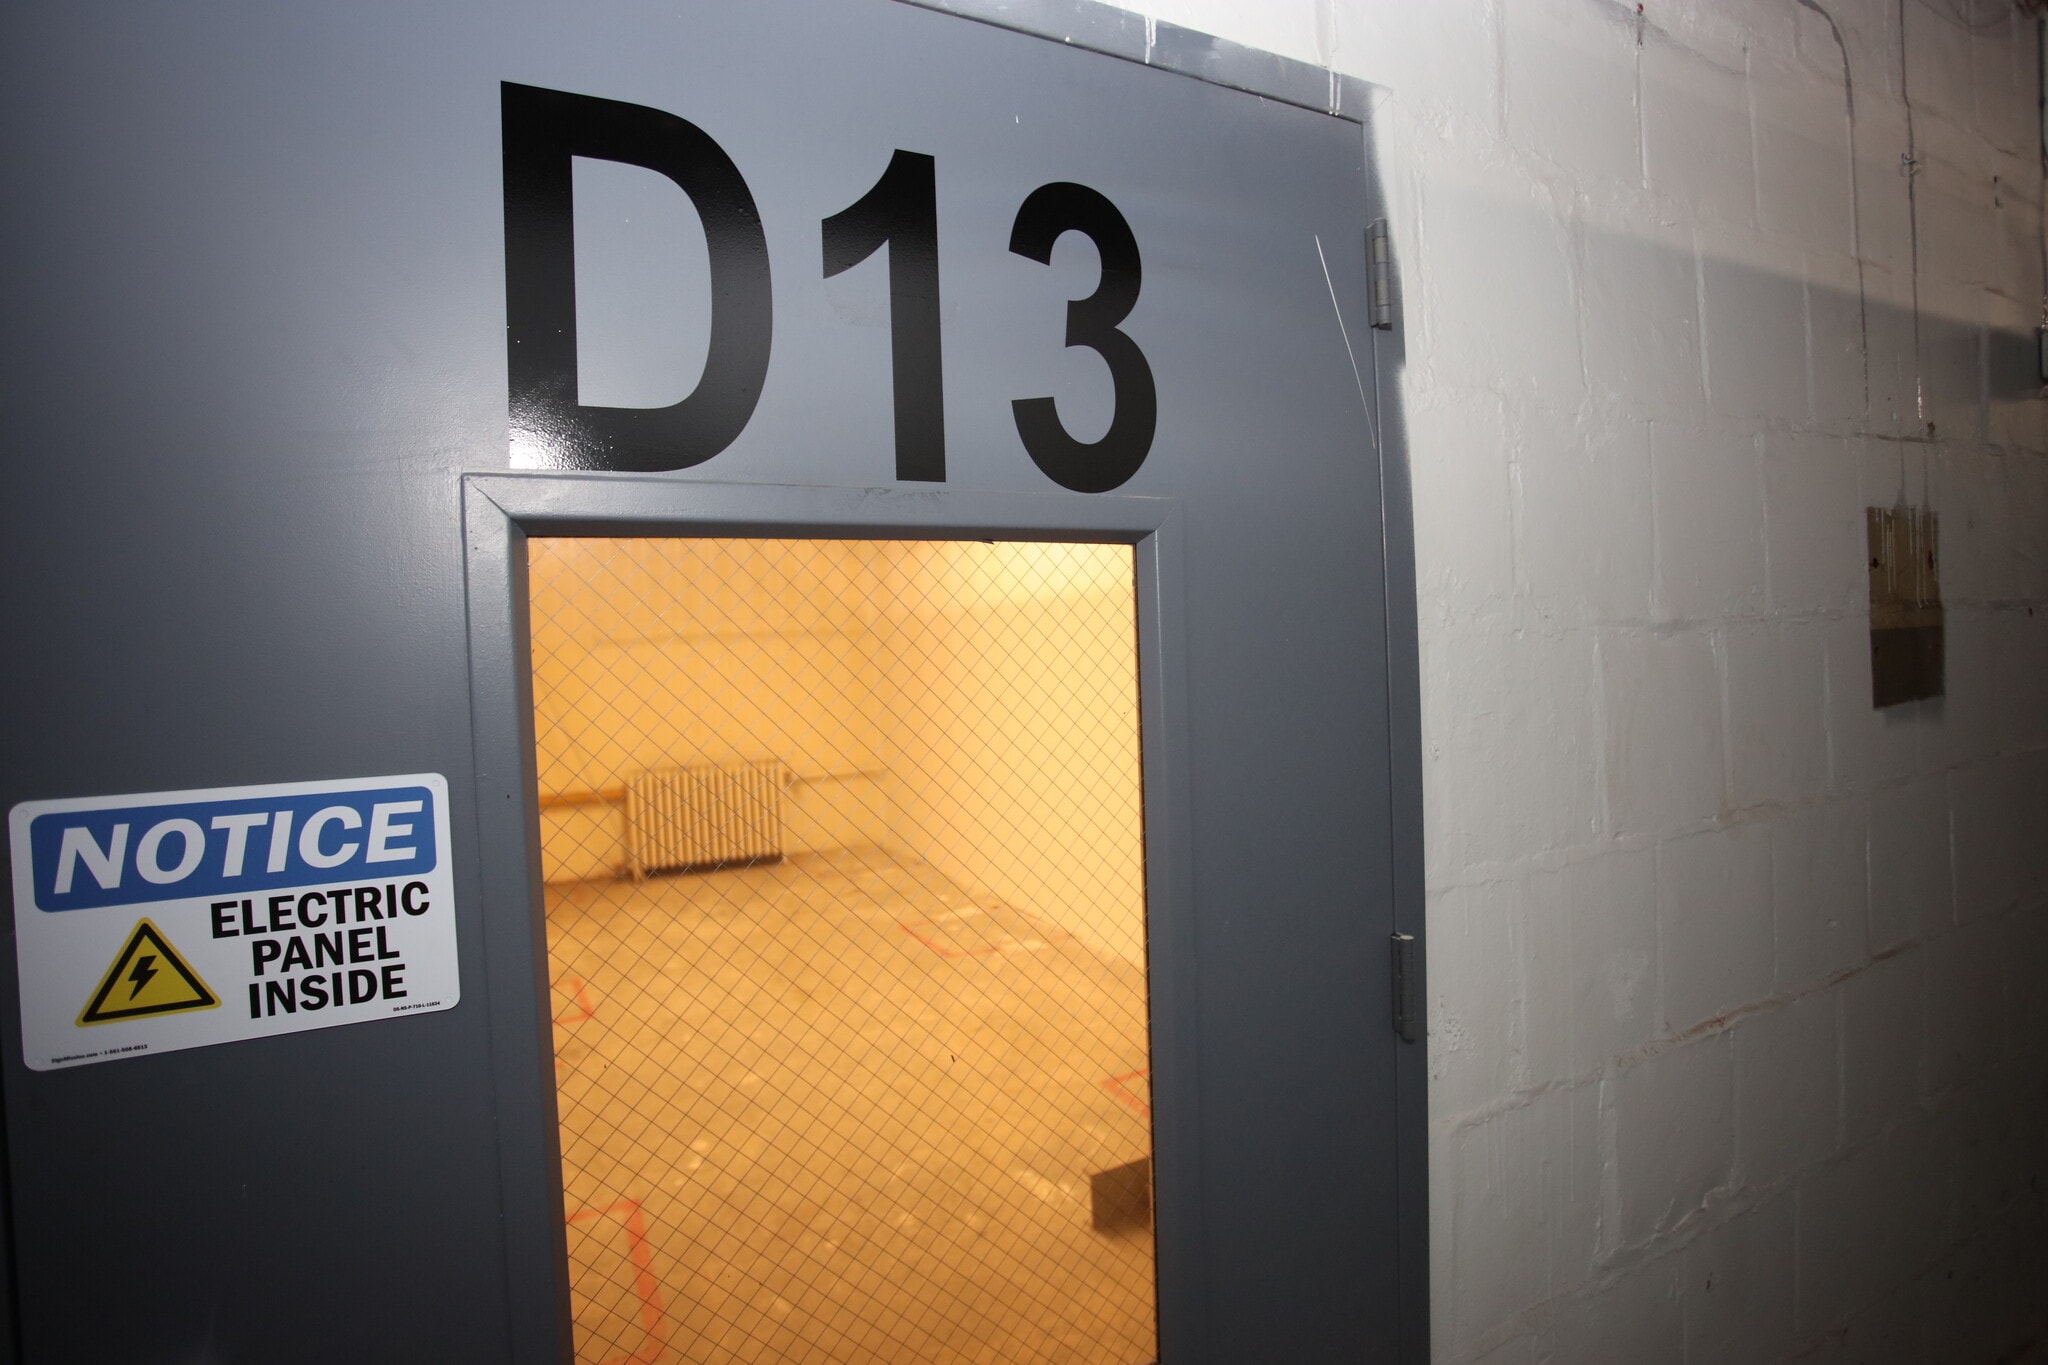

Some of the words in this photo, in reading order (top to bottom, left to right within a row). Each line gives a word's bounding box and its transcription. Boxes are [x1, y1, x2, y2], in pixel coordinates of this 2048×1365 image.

[500, 80, 1158, 494] D13
[53, 799, 425, 895] NOTICE
[210, 880, 430, 939] ELECTRIC
[252, 926, 400, 976] PANEL
[248, 964, 408, 1019] INSIDE
